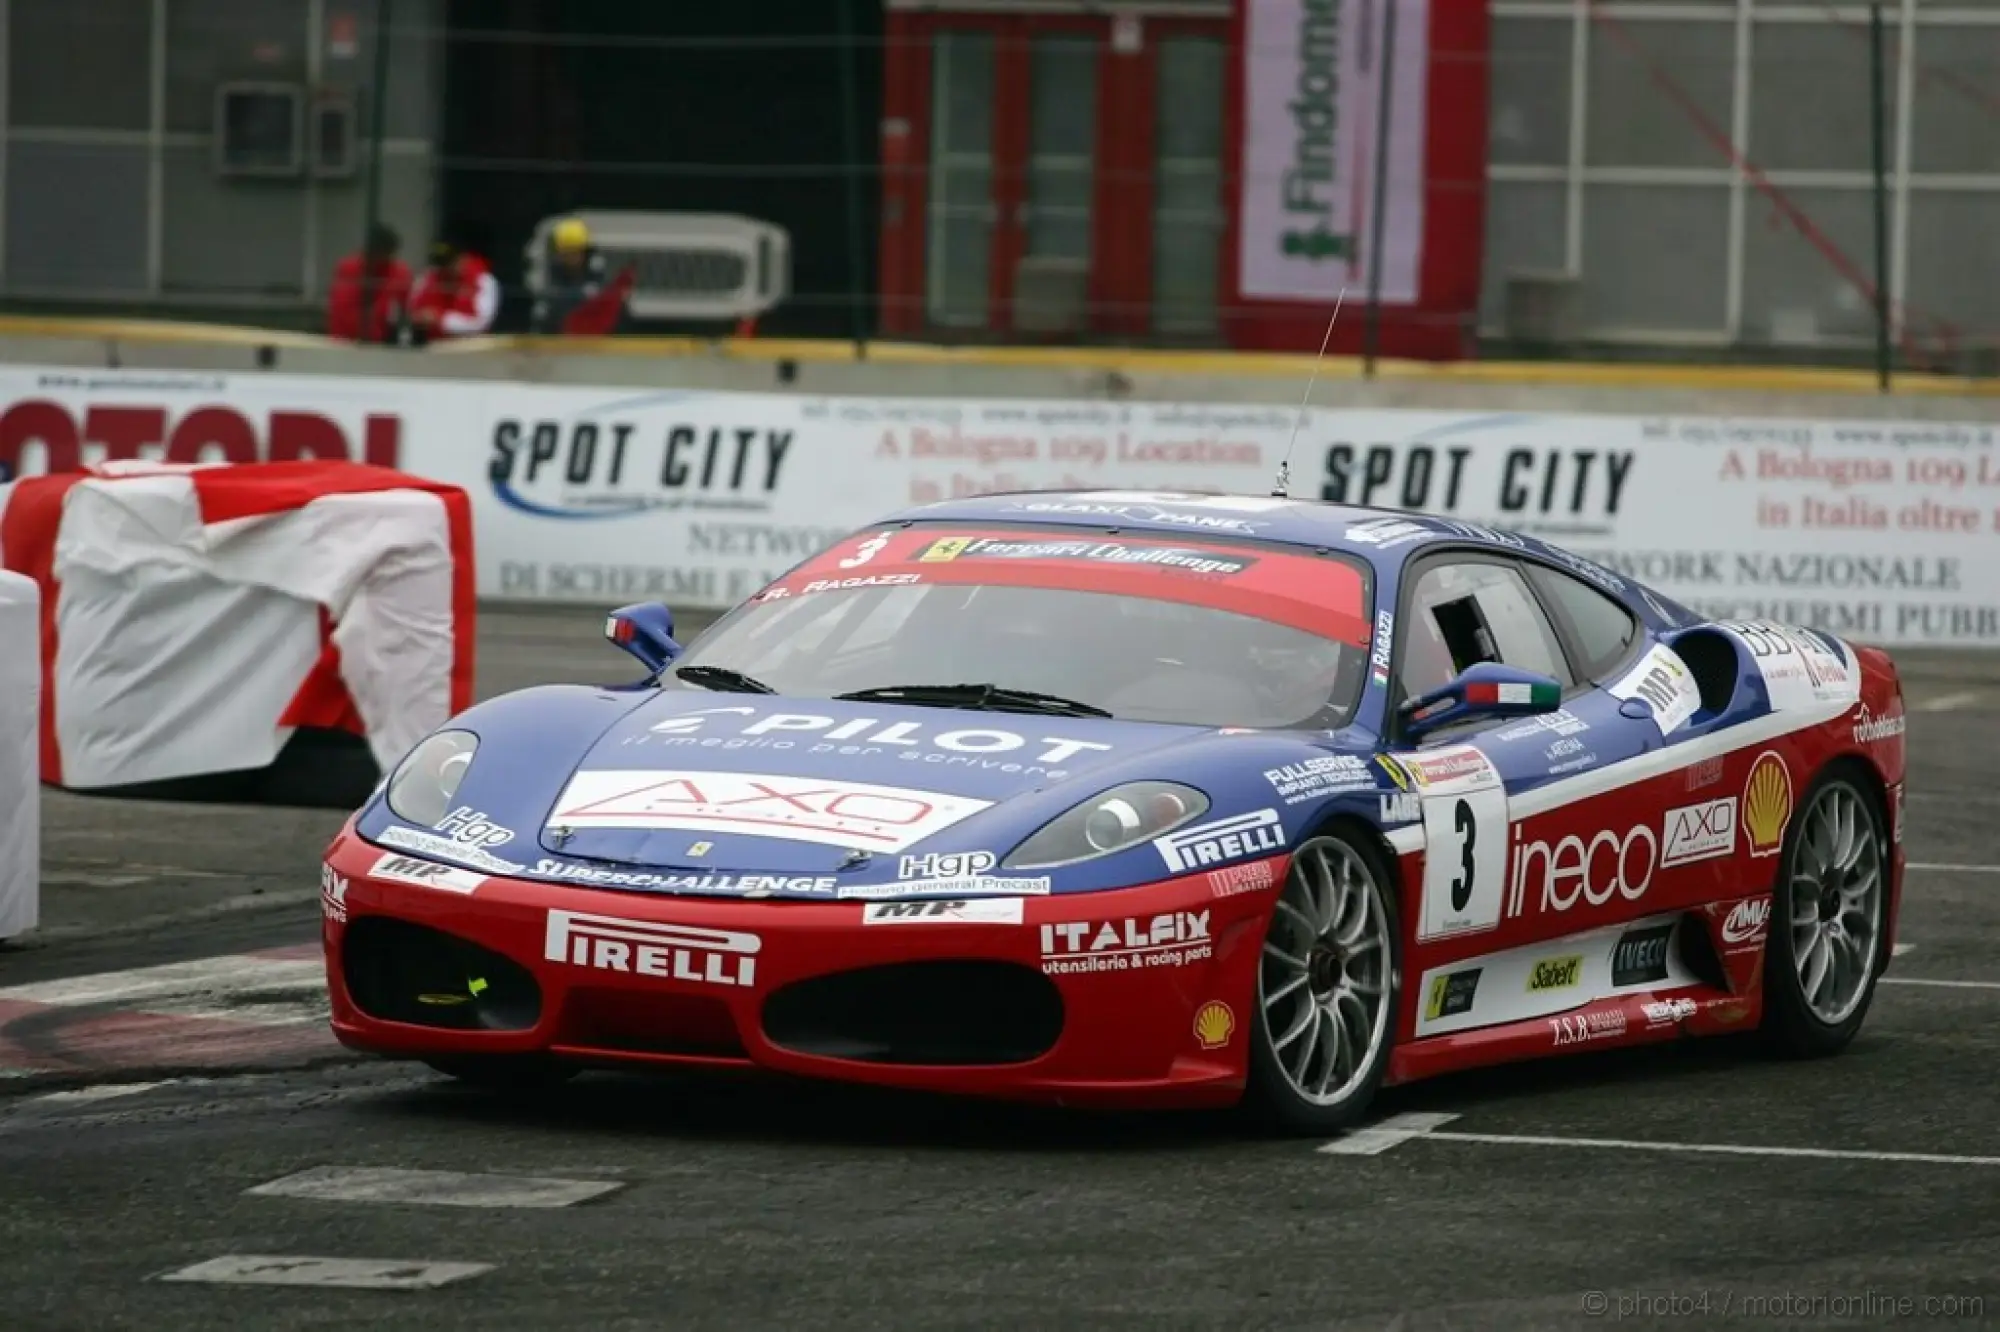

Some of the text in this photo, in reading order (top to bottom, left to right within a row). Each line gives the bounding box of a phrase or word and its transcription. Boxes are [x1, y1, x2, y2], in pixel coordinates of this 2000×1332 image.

[489, 419, 793, 491] SPOT CITY
[876, 430, 900, 457] A
[1117, 431, 1262, 464] Location
[1321, 445, 1635, 514] SPOT CITY
[1719, 450, 1745, 482] A
[1756, 450, 1894, 488] Bologna
[1906, 458, 1967, 491] 109
[1757, 494, 1981, 532] in Italia oltre
[839, 531, 892, 568] 3
[966, 538, 1242, 573] Ferrari Challenge
[761, 573, 922, 602] R. RAGAZZI
[1735, 552, 1962, 590] NAZIONALE
[621, 735, 1069, 779] il meglio per scrivere
[739, 713, 1113, 763] PILOT
[559, 778, 934, 826] AXO
[432, 806, 515, 848] Hgp
[1152, 808, 1286, 873] PIRELLI
[1666, 802, 1732, 855] AXO
[530, 858, 837, 893] SUPERCHALLENGE
[898, 851, 996, 879] Hgp
[1452, 798, 1476, 913] 3
[1507, 823, 1657, 919] ineco
[981, 876, 1048, 891] Precast
[544, 908, 761, 987] PIRELLI
[1040, 908, 1211, 953] ITALFIX
[1042, 945, 1212, 974] utensileria & racing parts
[1617, 940, 1669, 972] IVECO
[1549, 1016, 1591, 1046] T.S.B.
